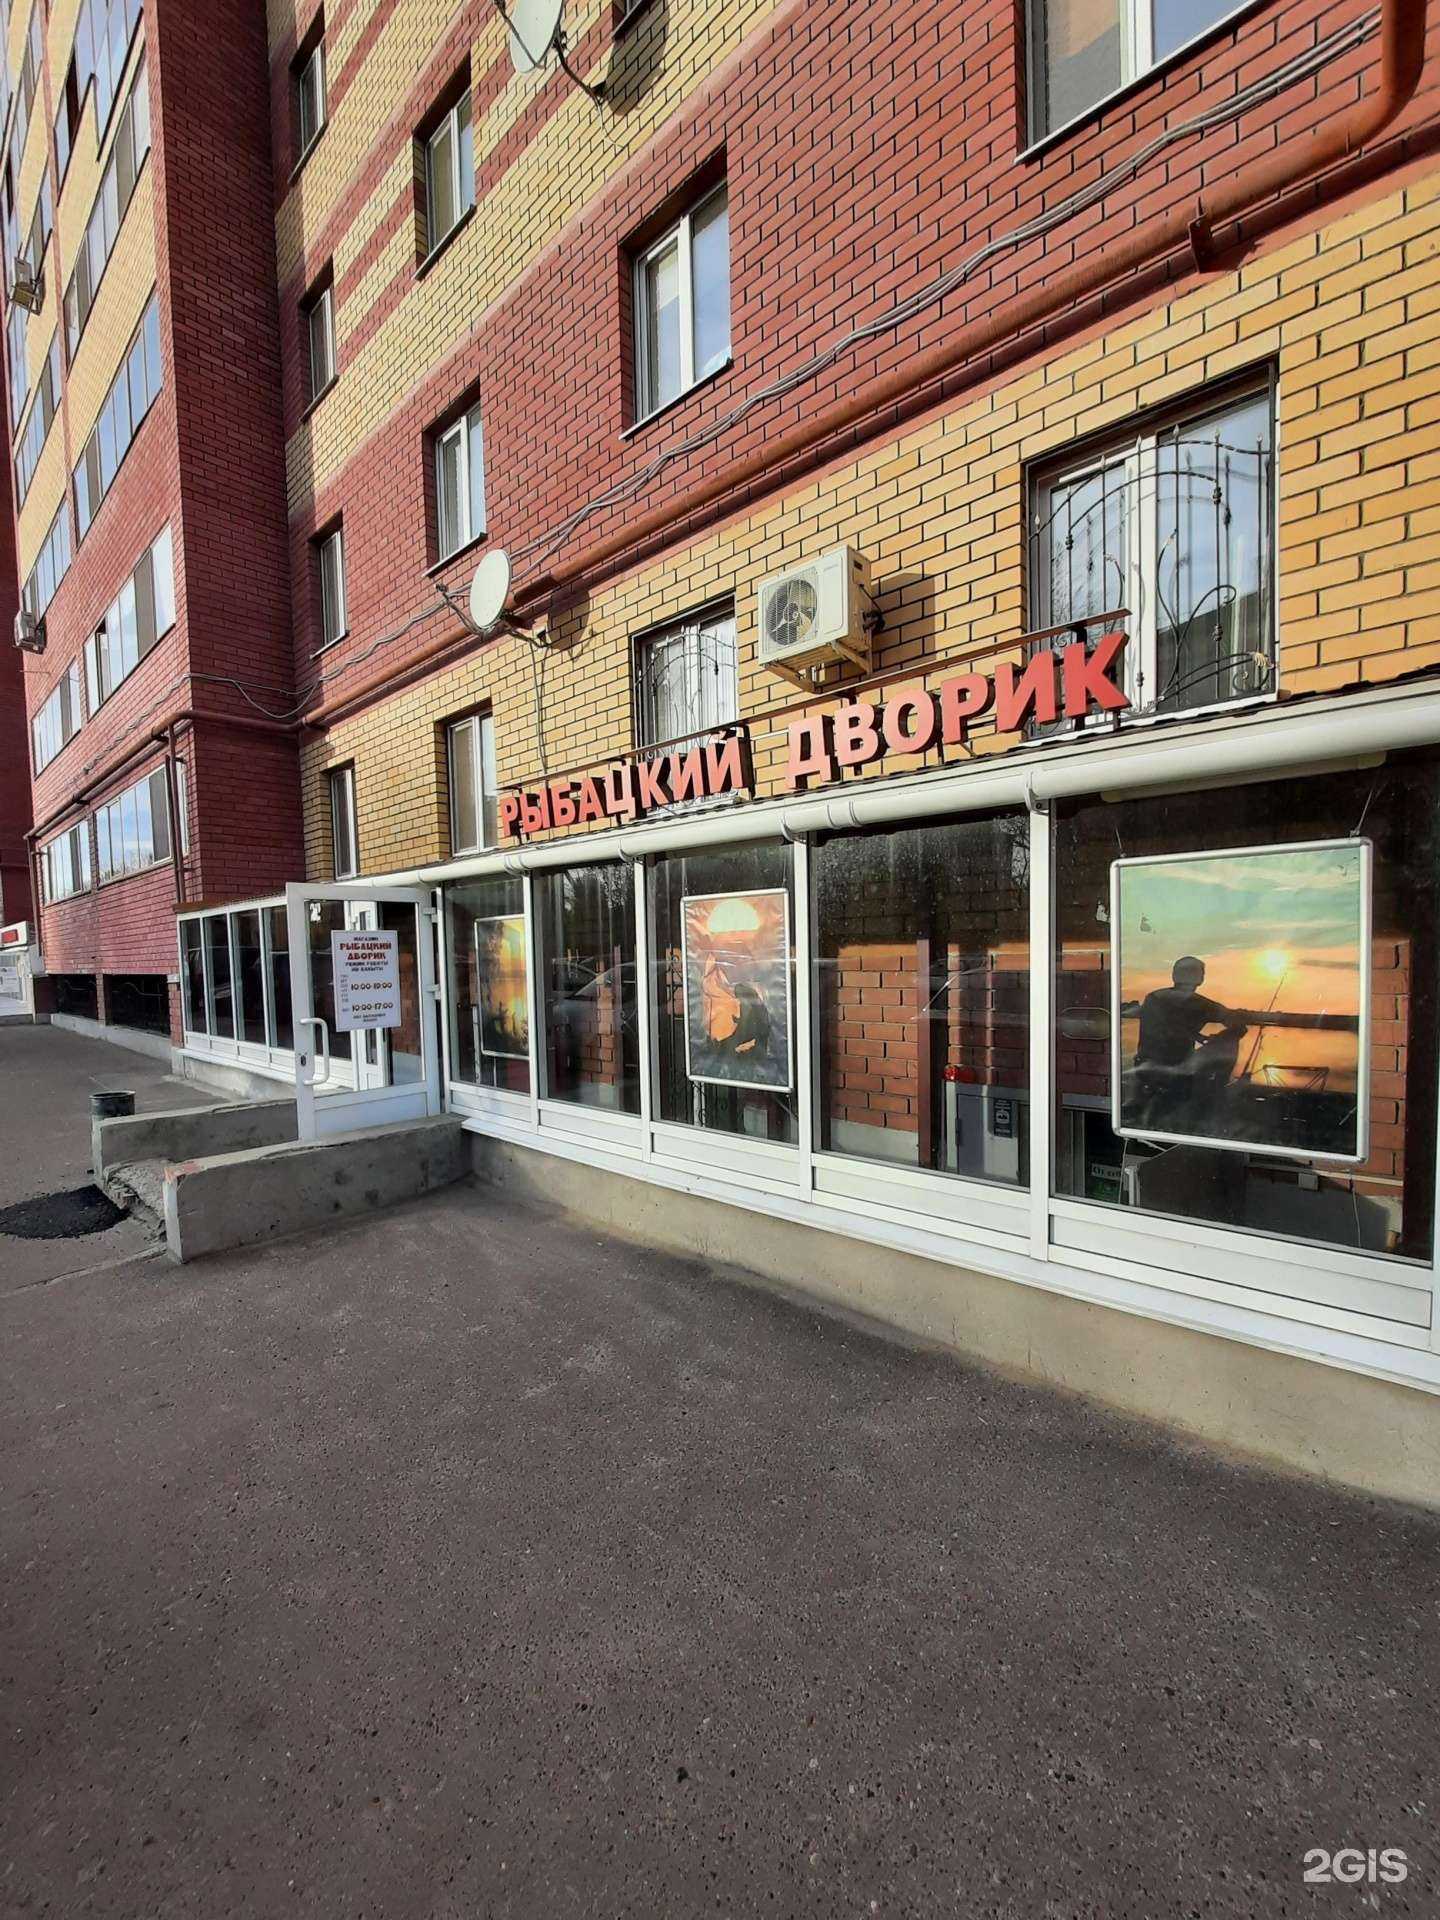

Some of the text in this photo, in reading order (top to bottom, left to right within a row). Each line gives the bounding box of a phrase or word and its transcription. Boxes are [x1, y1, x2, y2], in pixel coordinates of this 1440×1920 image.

[499, 631, 1133, 837] РЫБАЦКИЙ ДВОРИК
[340, 942, 392, 951] РЫБАЦКИЙ
[347, 952, 386, 960] ДВОРИК
